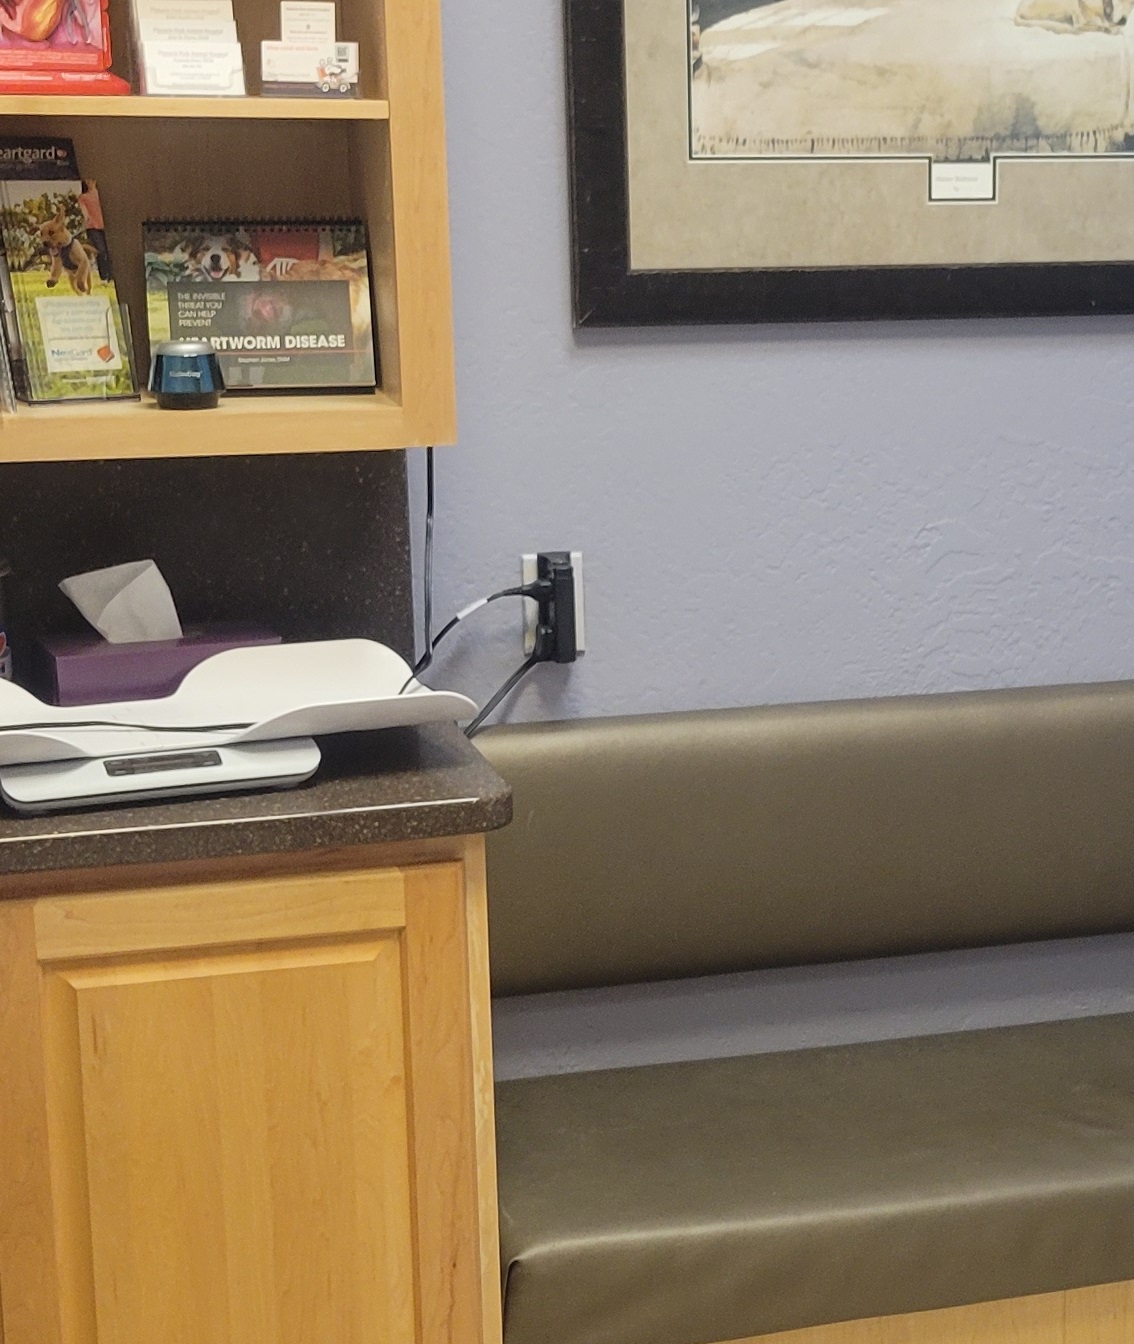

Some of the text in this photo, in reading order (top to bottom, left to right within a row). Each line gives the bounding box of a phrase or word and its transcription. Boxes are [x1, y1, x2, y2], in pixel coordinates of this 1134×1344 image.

[0, 146, 55, 164] eartgard
[178, 292, 226, 301] THE INVISIBLE
[206, 301, 222, 309] YOU
[178, 309, 217, 318] CAN HELP
[179, 319, 212, 327] PREVENT
[284, 335, 346, 348] DISEASE
